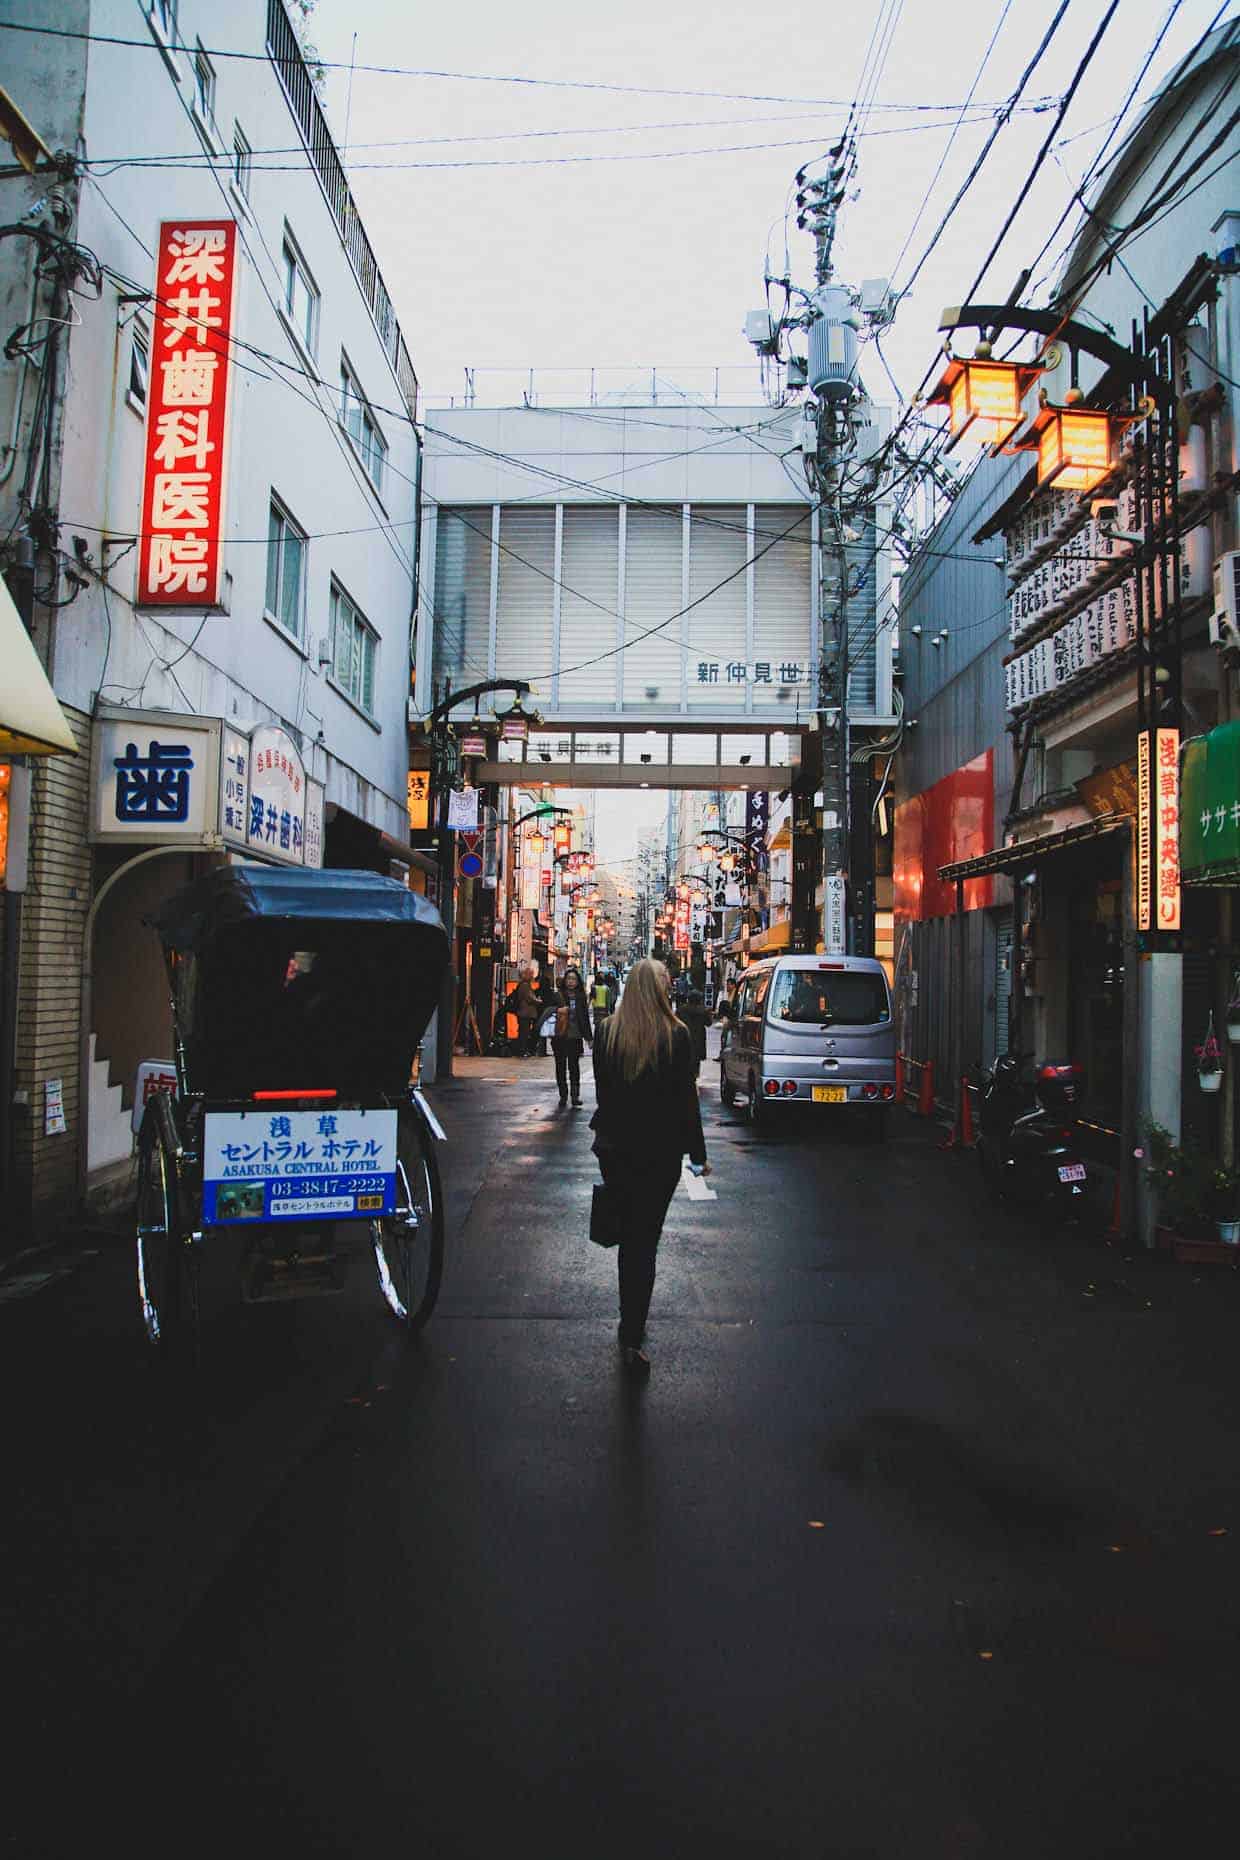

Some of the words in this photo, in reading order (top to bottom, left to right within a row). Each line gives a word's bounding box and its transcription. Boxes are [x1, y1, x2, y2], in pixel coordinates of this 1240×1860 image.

[147, 228, 228, 594] 深井歯科医院
[697, 662, 800, 684] 新仲見世
[114, 740, 194, 823] 歯
[1160, 736, 1178, 922] 浅草中央通り
[270, 1115, 338, 1138] 浅草
[221, 1141, 314, 1162] セントラル
[322, 1139, 383, 1160] ホテル
[223, 1163, 281, 1177] ASAKUSA
[284, 1161, 338, 1175] CENTRAL
[342, 1160, 381, 1173] HOTEL
[272, 1200, 352, 1211] 浅草セントラルホテル
